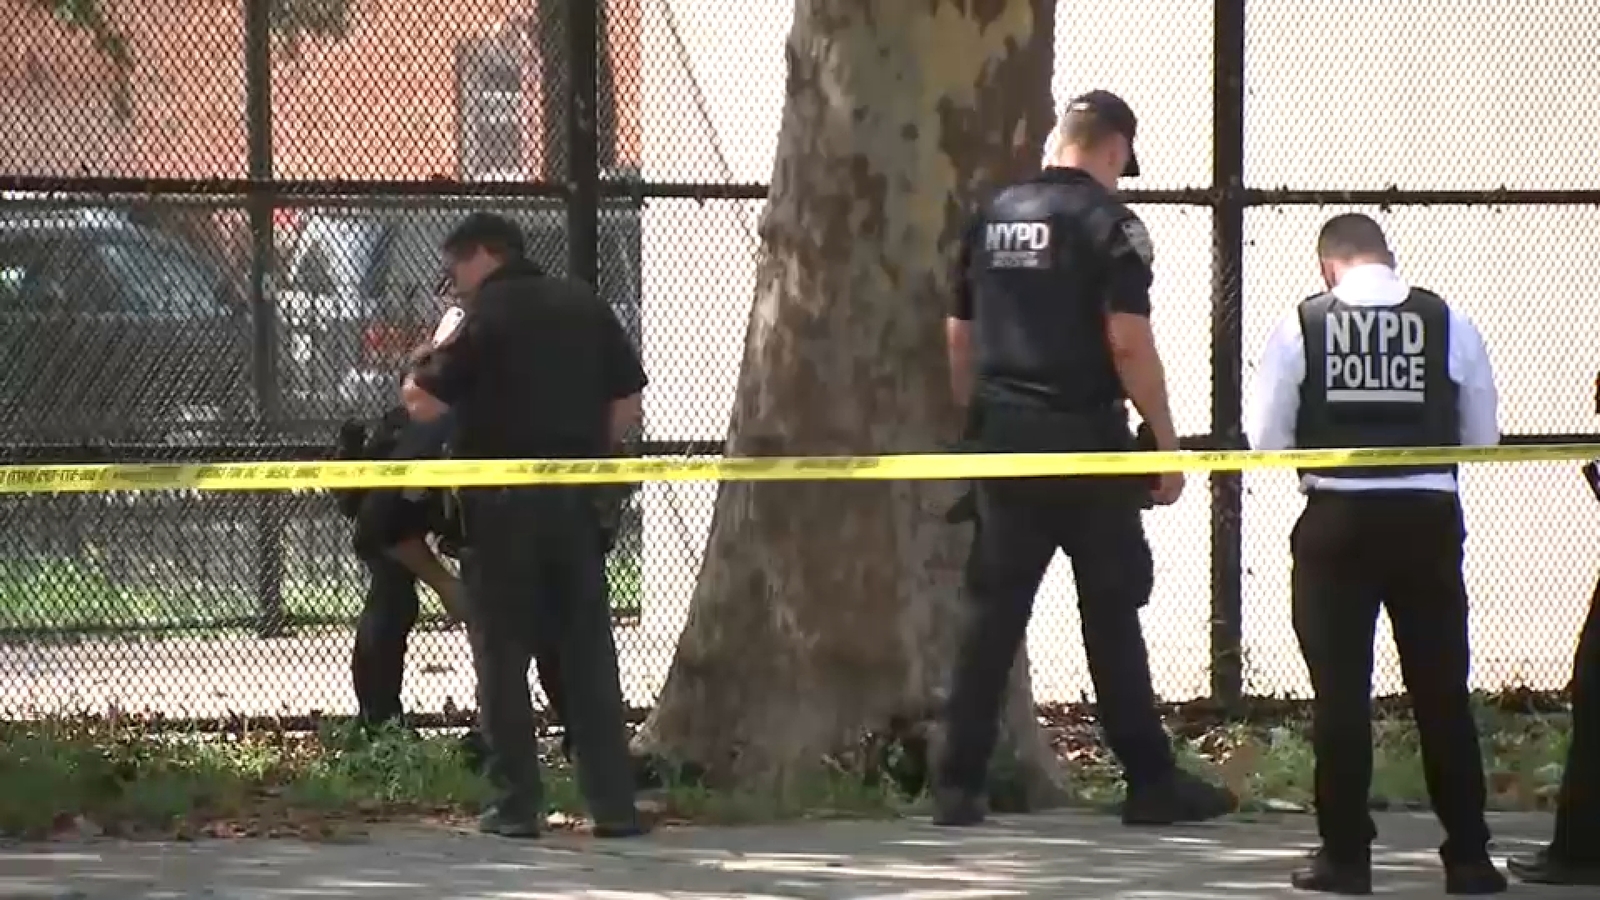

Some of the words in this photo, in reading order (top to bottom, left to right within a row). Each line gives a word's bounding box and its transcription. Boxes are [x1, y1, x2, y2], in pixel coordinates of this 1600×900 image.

[985, 222, 1049, 250] NYPD
[1326, 311, 1424, 353] NYPD
[1326, 355, 1425, 389] POLICE
